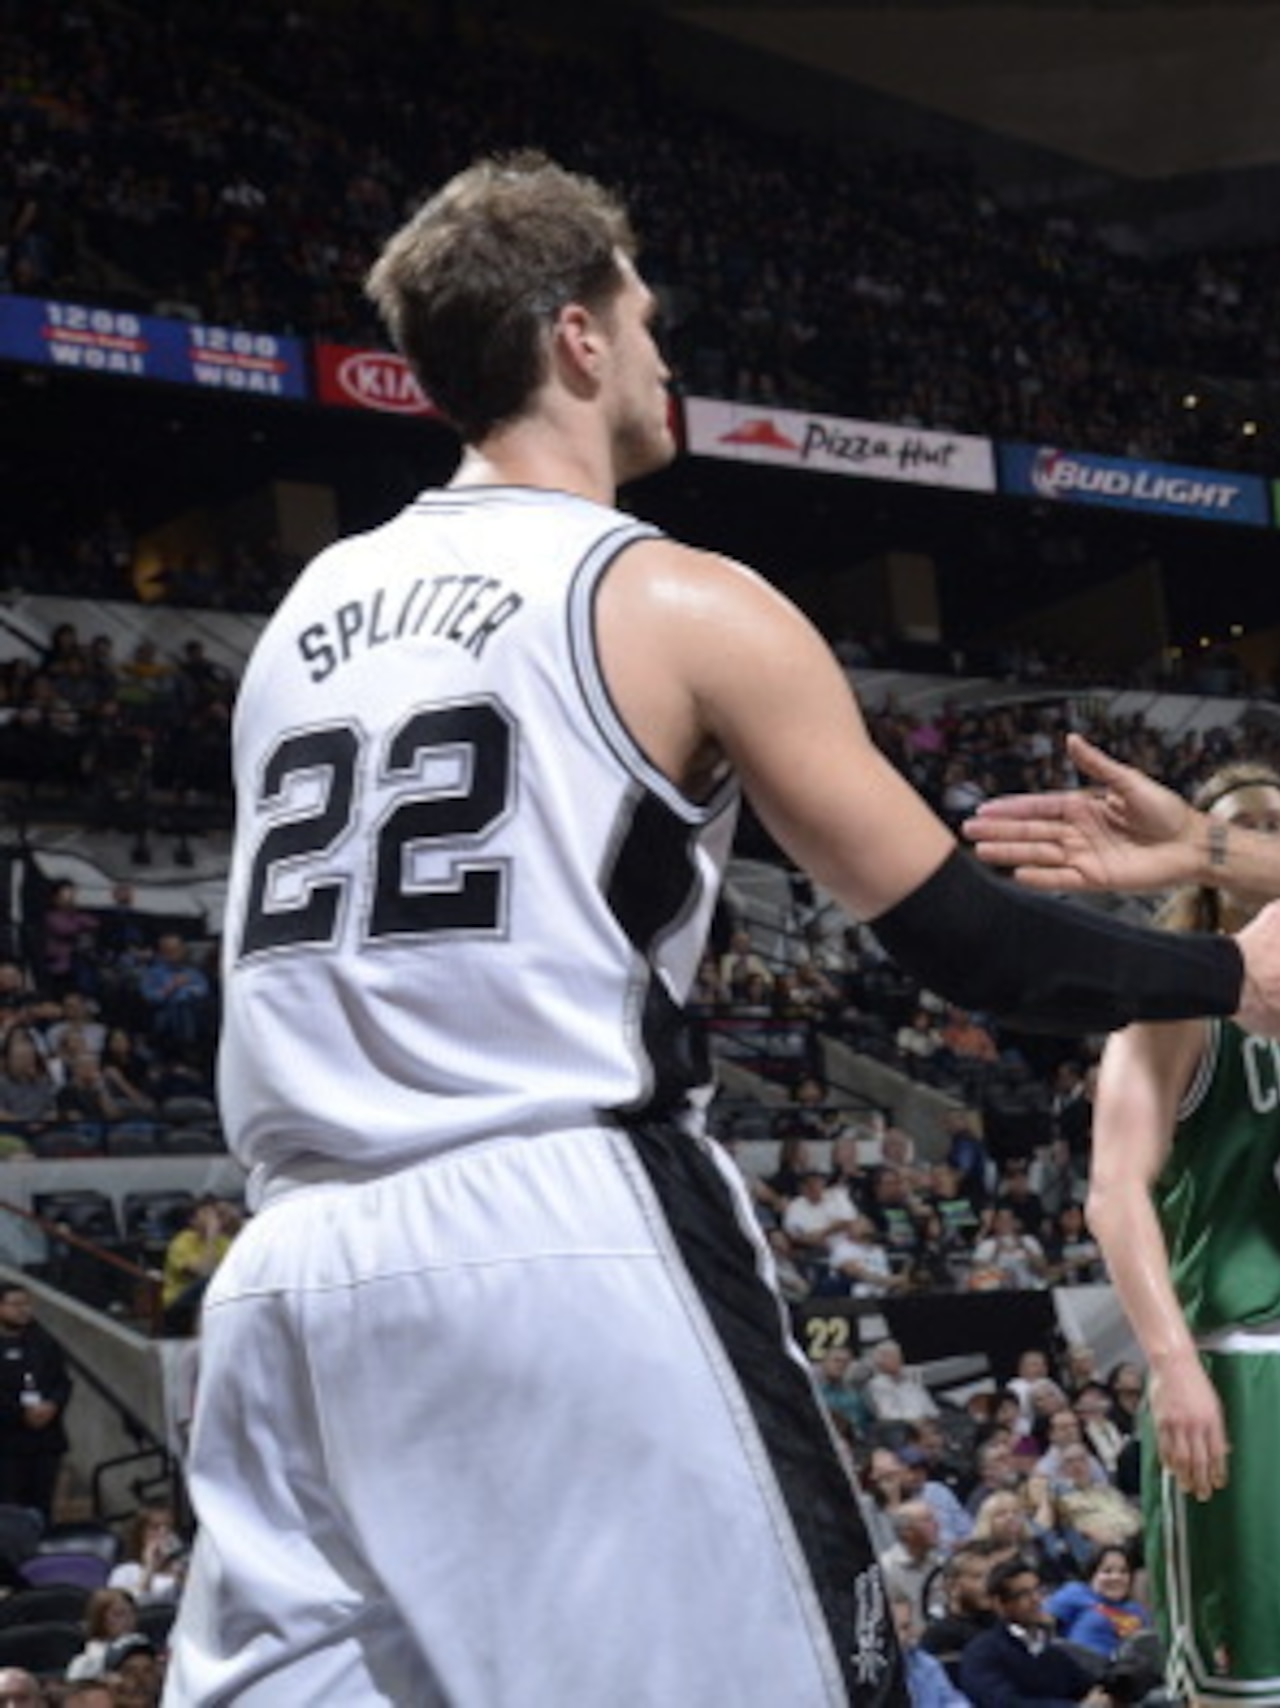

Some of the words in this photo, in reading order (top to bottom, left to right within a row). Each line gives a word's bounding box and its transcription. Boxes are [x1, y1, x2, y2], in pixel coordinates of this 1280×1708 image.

[46, 303, 139, 337] 1200
[49, 341, 144, 374] WOAI
[189, 324, 278, 357] 1200
[193, 362, 282, 394] WOAI
[357, 362, 427, 401] KIA
[803, 421, 890, 460] Pizza
[898, 437, 955, 469] Hut
[297, 574, 524, 684] SPLITTER
[236, 692, 519, 968] 22
[806, 1316, 850, 1359] 22
